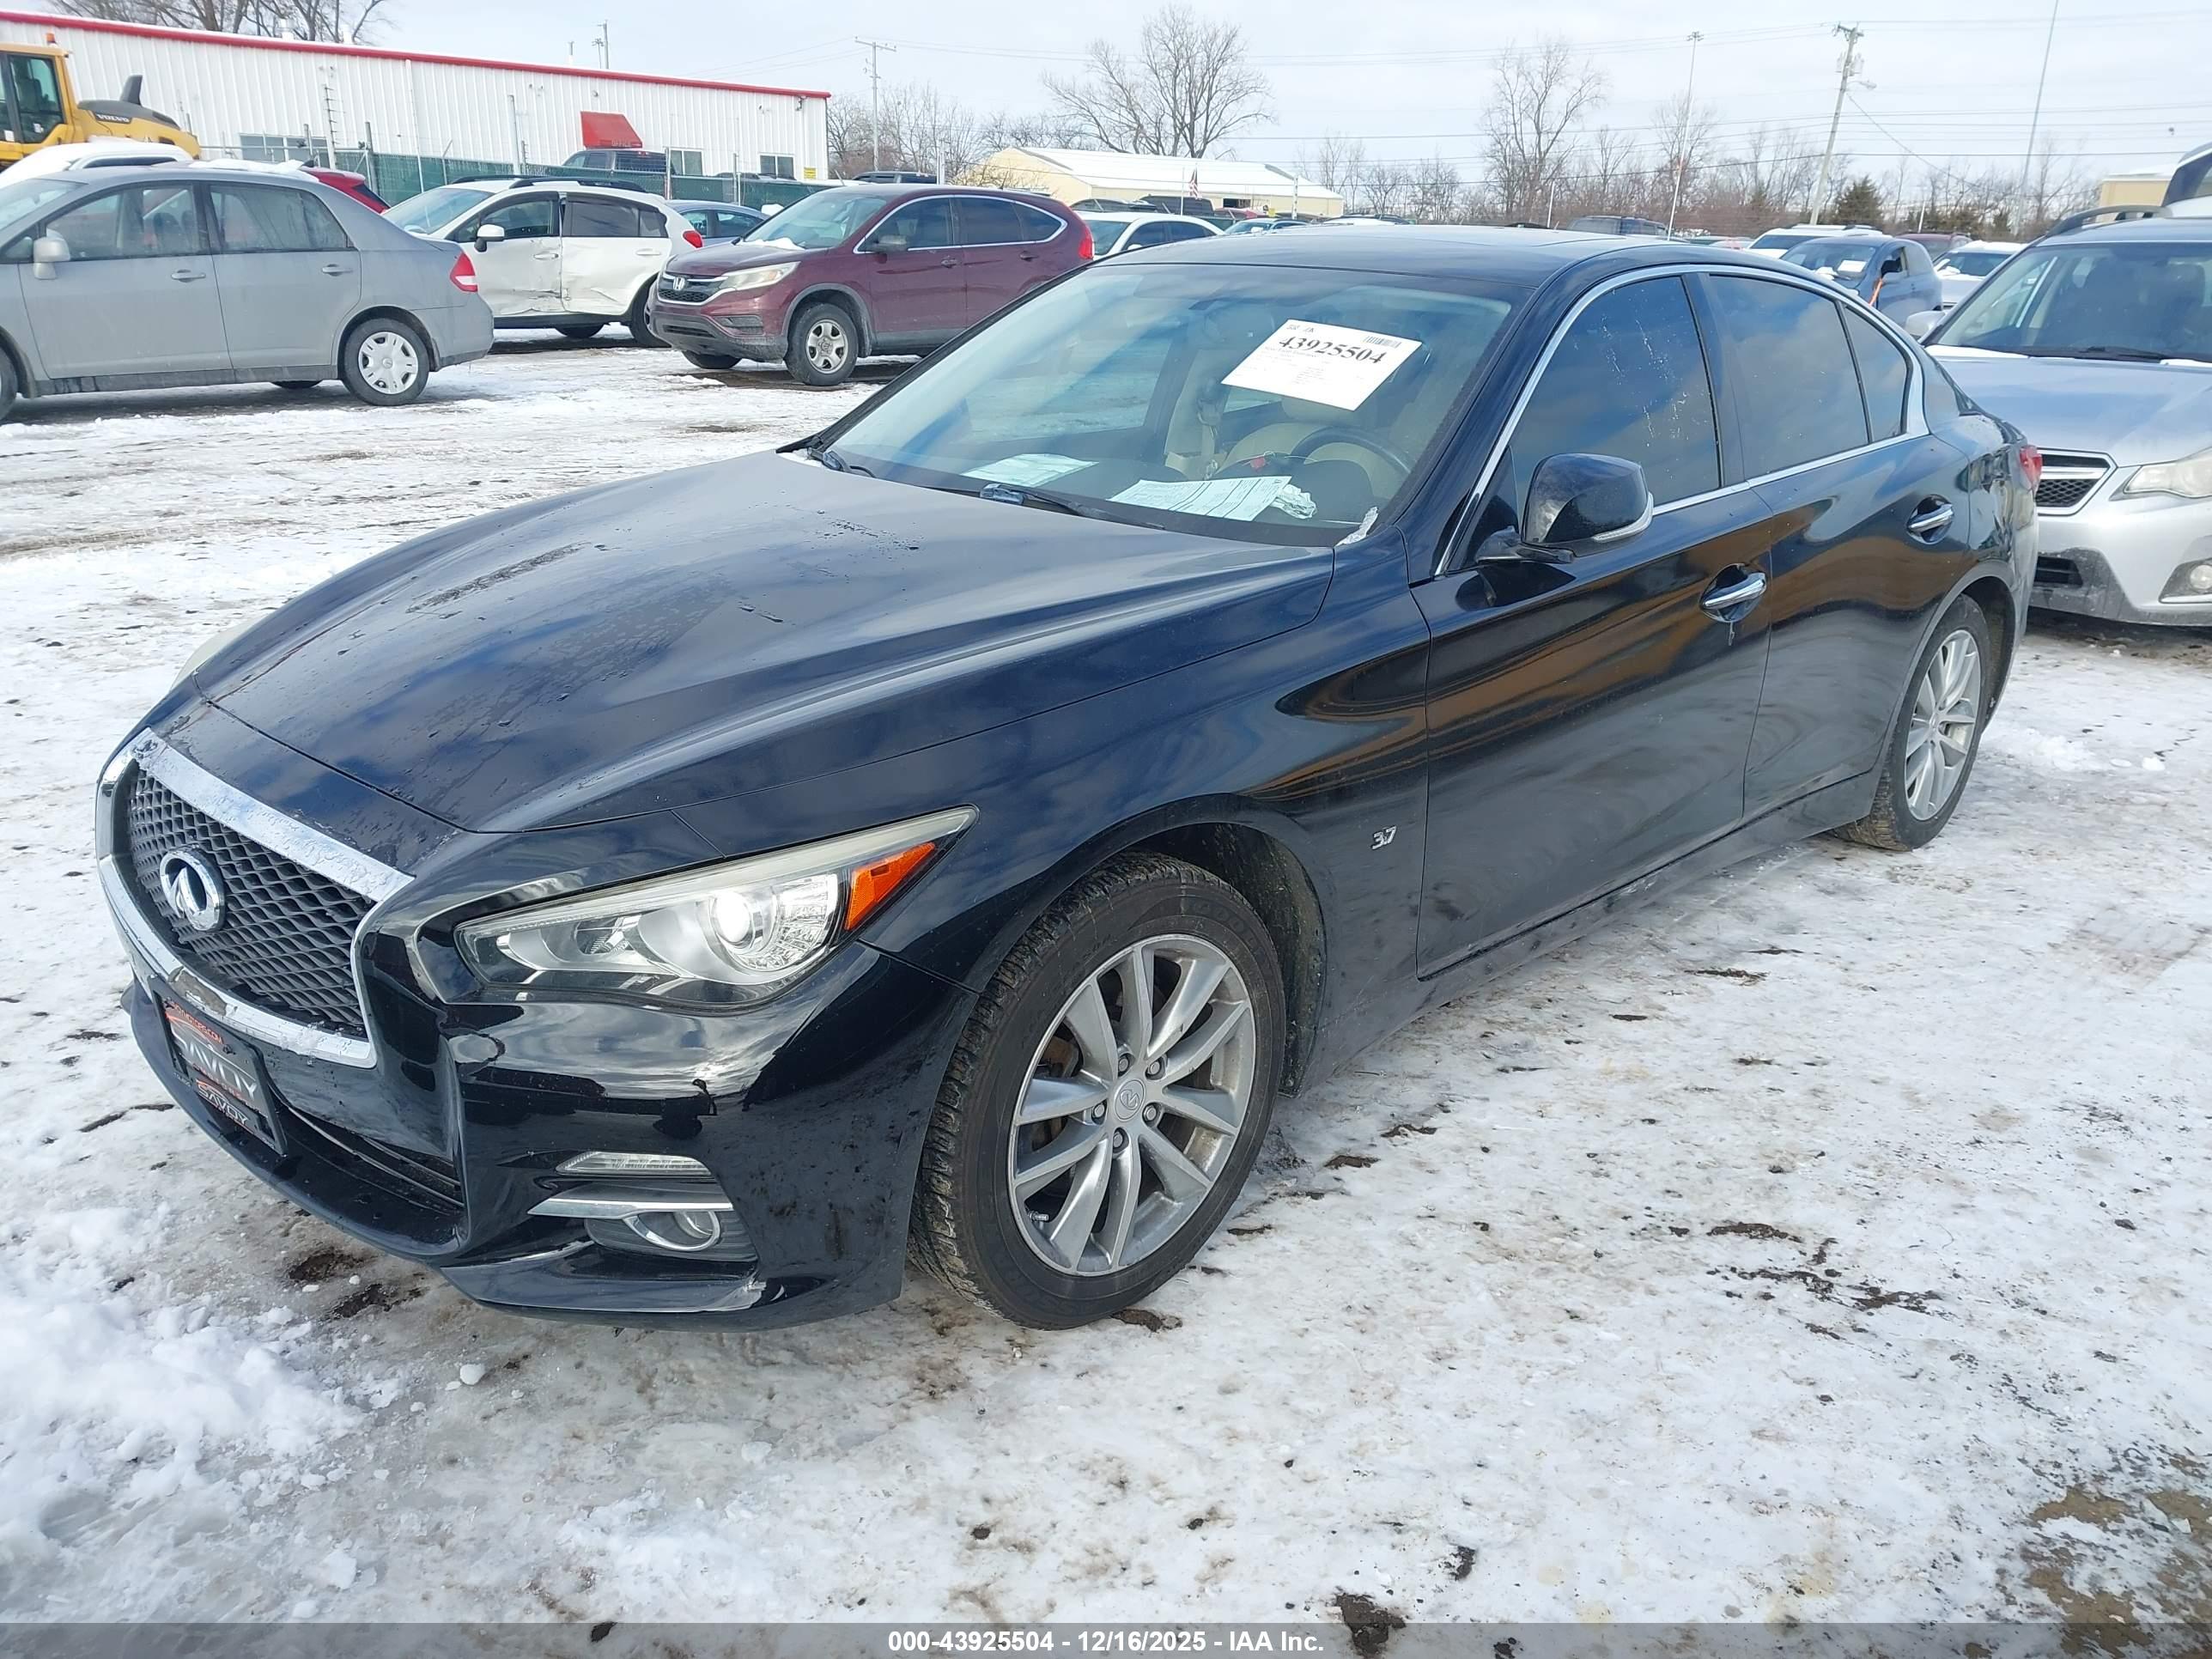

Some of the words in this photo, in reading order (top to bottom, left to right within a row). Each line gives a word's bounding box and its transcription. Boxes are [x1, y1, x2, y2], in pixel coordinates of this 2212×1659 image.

[96, 114, 130, 123] VOLVO
[1279, 336, 1387, 364] 43925504
[198, 1084, 249, 1125] SAVOY
